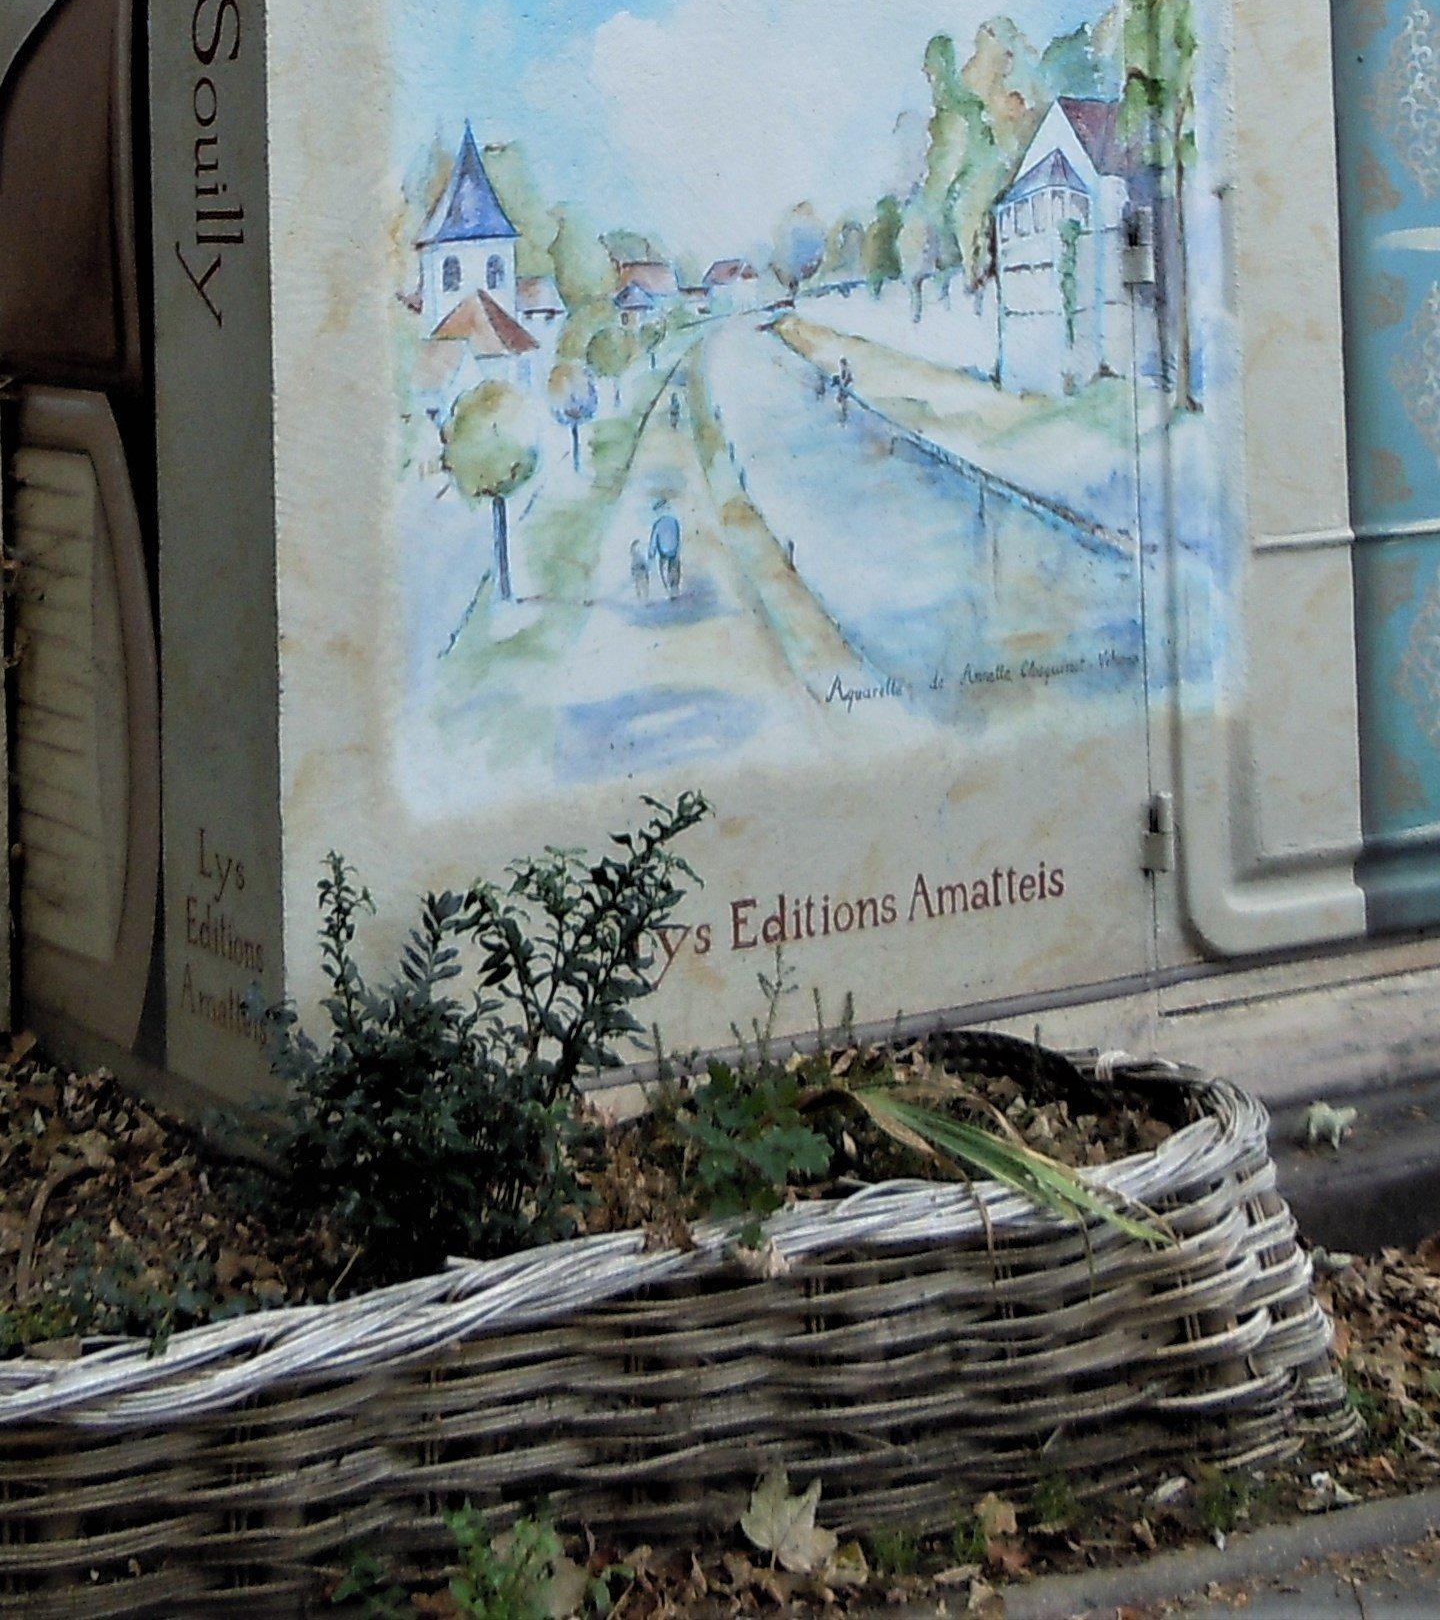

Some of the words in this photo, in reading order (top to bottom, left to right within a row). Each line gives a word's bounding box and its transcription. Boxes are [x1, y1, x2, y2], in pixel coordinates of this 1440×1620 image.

[199, 828, 246, 903] Lys
[186, 896, 264, 974] Editions
[634, 922, 712, 992] ys
[730, 891, 898, 951] Editions
[908, 860, 1066, 922] Amatteis
